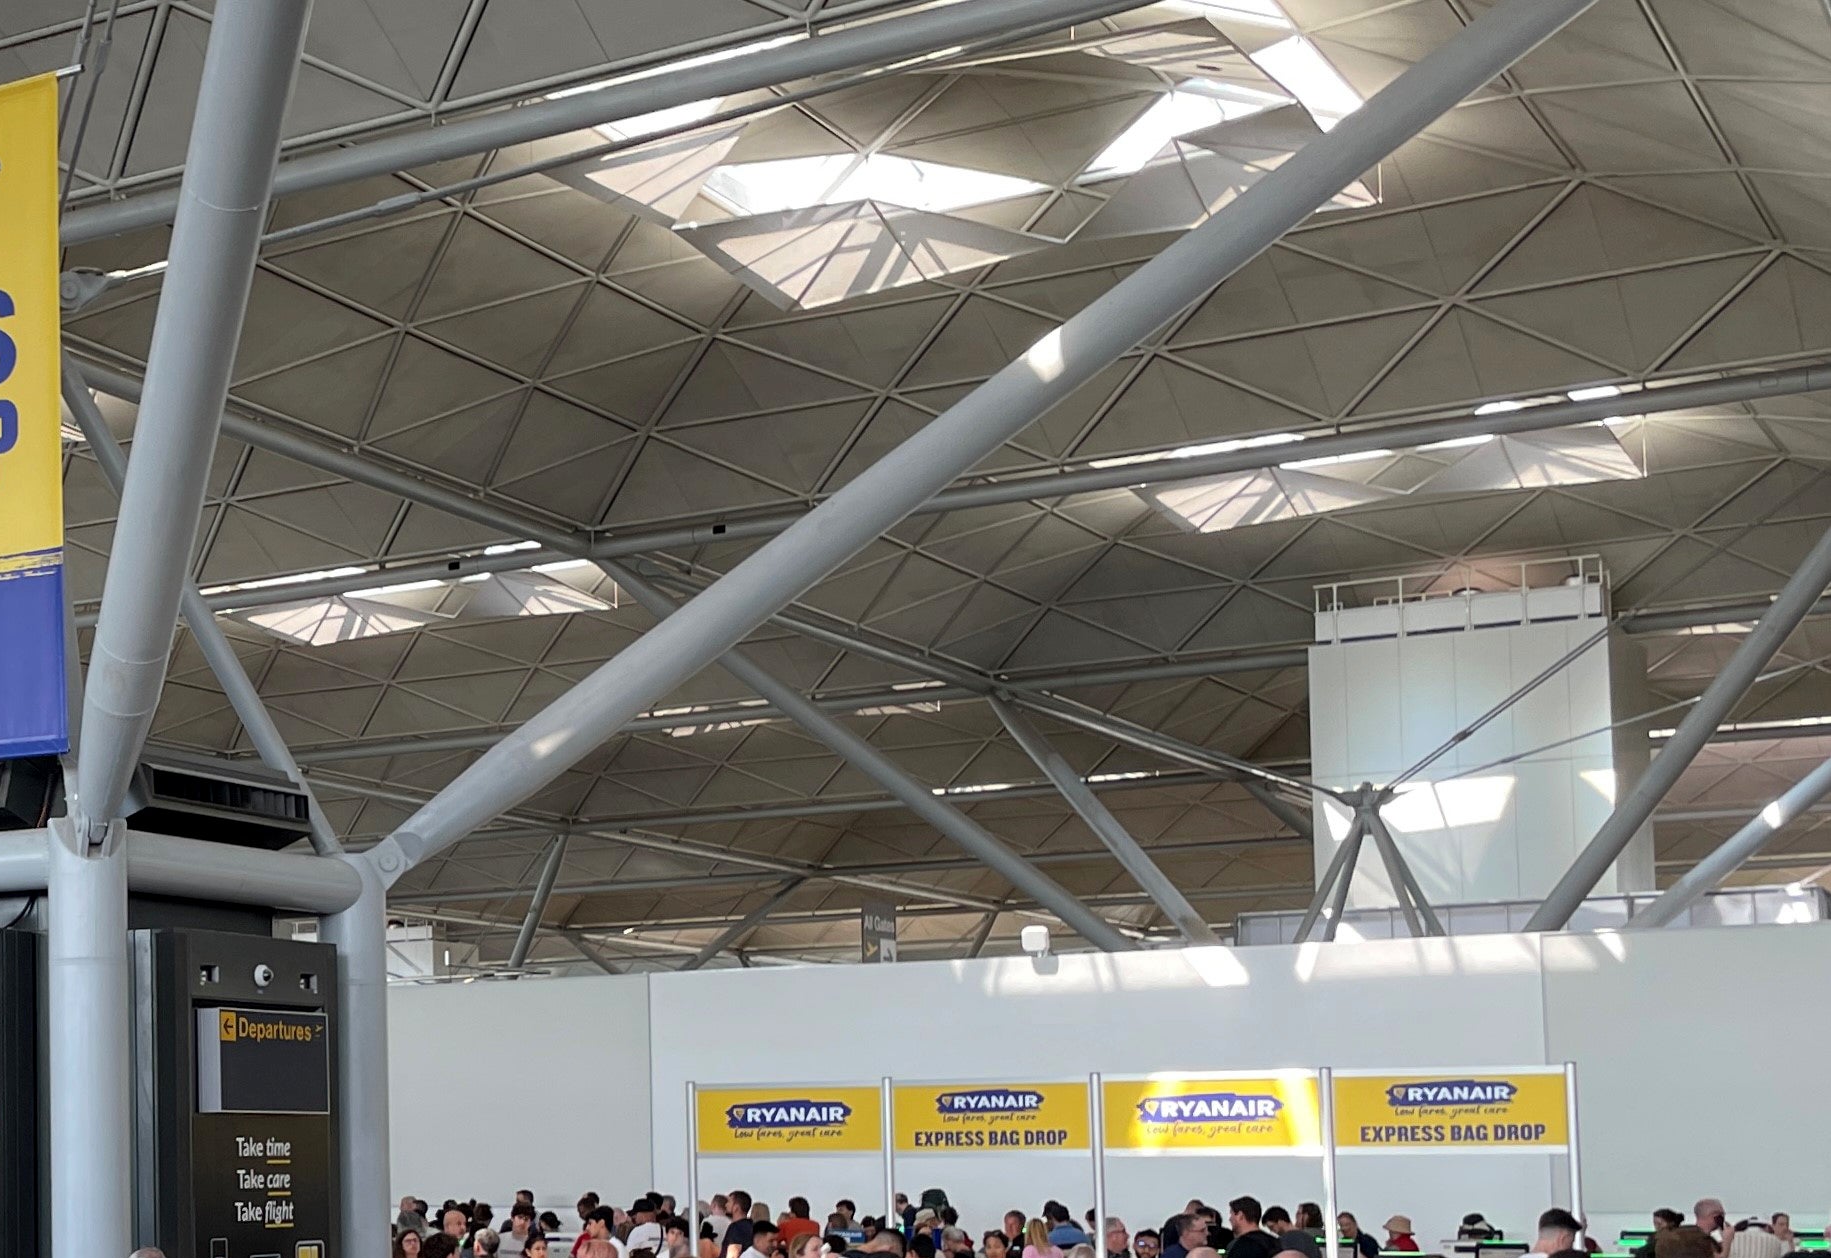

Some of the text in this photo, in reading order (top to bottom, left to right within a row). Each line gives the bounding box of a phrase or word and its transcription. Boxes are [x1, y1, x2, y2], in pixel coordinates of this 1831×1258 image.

[239, 1017, 312, 1042] Departures
[954, 1094, 1039, 1110] RYANAIR
[1407, 1085, 1511, 1102] RYANAIR
[747, 1105, 845, 1124] RYANAIR
[1161, 1100, 1275, 1117] RYANAIR
[1394, 1106, 1415, 1117] Low
[1450, 1105, 1481, 1120] great
[1483, 1106, 1508, 1115] care
[943, 1113, 960, 1122] Low
[988, 1112, 1014, 1125] great
[1016, 1113, 1037, 1121] care
[734, 1127, 842, 1142] Low fares, great care
[915, 1129, 1068, 1147] EXPRESS BAG DROP
[1147, 1121, 1274, 1138] Low fares, great care
[1360, 1124, 1546, 1142] EXPRESS BAG DROP
[235, 1137, 291, 1157] Take time
[236, 1169, 291, 1189] Take care
[235, 1200, 294, 1224] Take flight
